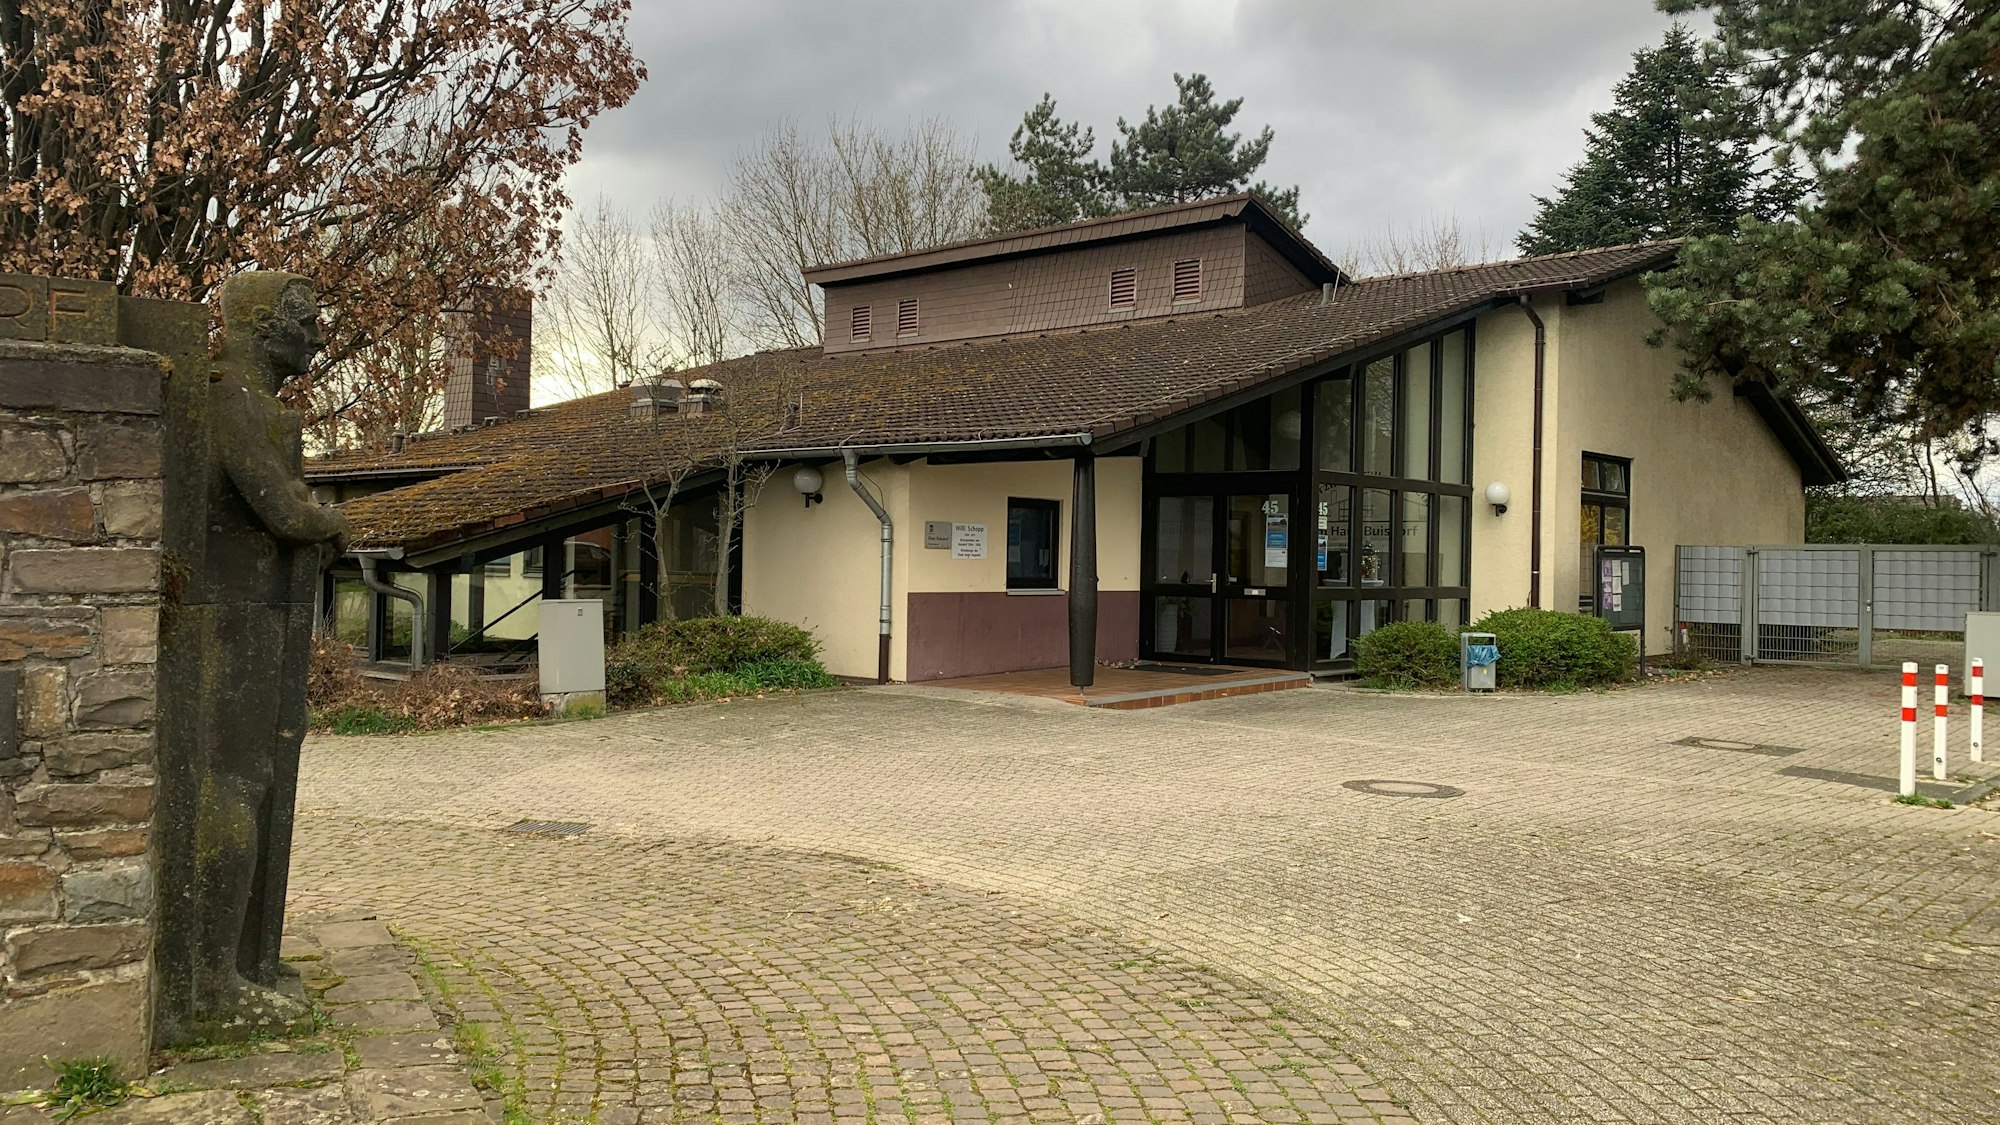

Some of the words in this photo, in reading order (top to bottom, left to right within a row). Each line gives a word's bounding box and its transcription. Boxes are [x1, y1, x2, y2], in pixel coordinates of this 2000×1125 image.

[1261, 500, 1279, 515] 45
[1318, 501, 1329, 516] 45
[967, 525, 985, 533] Schopp
